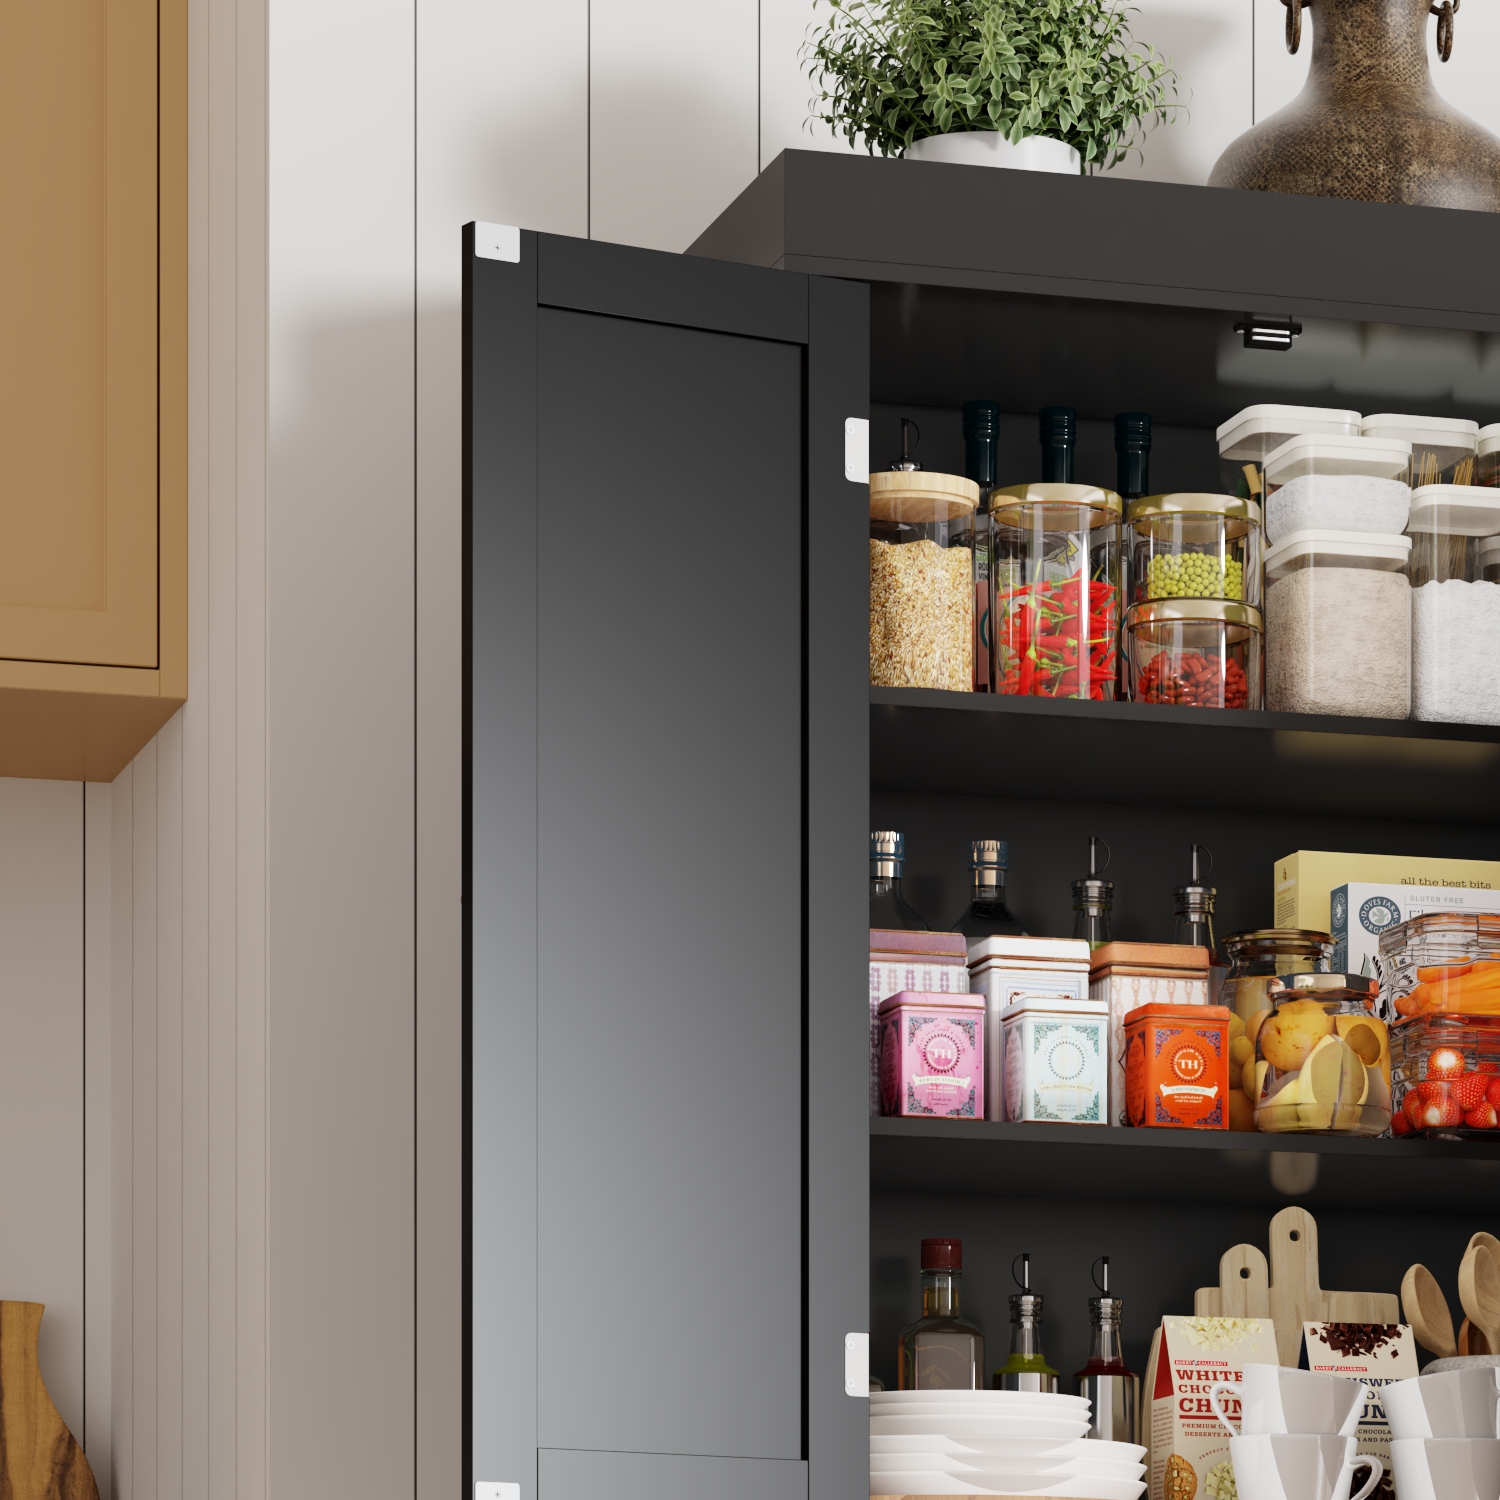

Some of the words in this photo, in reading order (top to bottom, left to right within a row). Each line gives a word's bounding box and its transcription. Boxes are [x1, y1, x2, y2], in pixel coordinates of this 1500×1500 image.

[1400, 877, 1416, 886] all
[1419, 878, 1439, 887] the
[1441, 879, 1467, 888] best
[1469, 880, 1492, 890] bits
[1409, 895, 1441, 904] GLUTEN
[1443, 896, 1464, 904] FREE
[1361, 899, 1381, 917] DOVES
[1383, 900, 1399, 919] FARM
[1176, 1370, 1243, 1382] WHITE
[1179, 1398, 1242, 1414] CHUN
